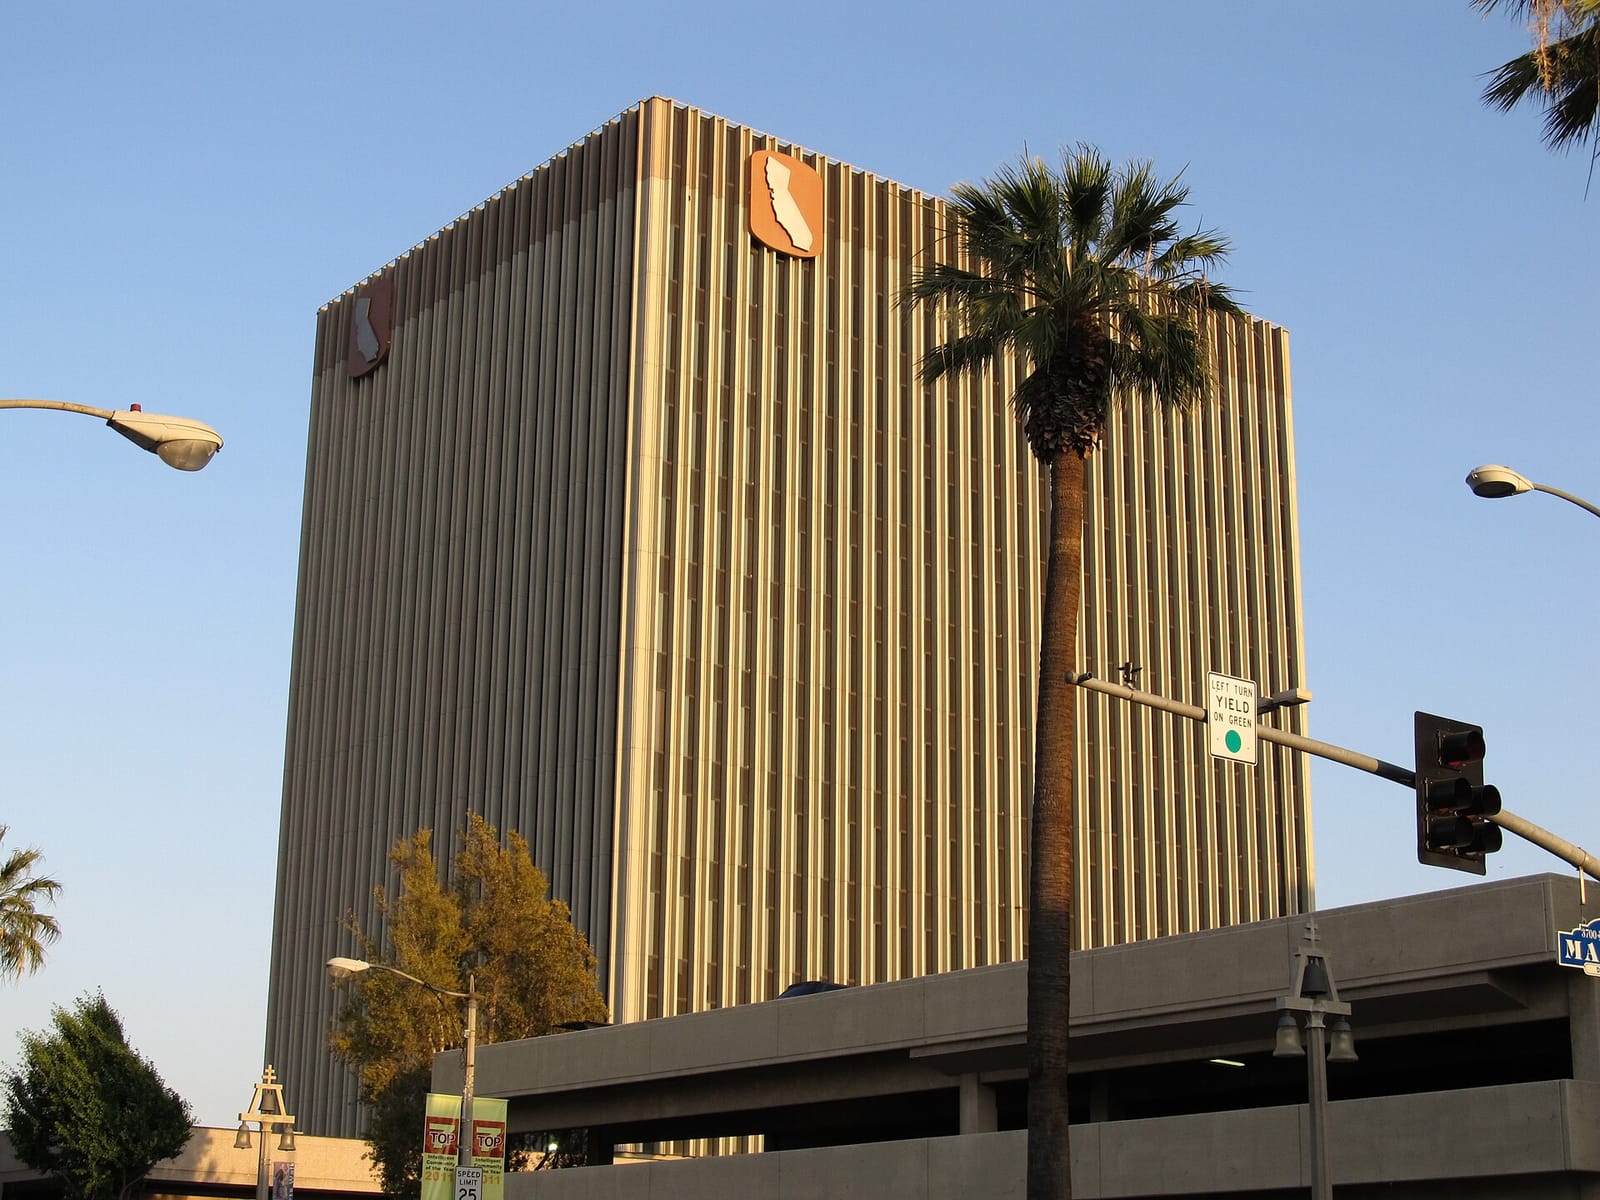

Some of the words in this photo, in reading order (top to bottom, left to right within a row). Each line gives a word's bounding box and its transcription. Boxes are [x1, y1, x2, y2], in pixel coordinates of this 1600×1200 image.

[1212, 680, 1229, 692] LEFT
[1235, 685, 1253, 697] TURN
[1216, 695, 1250, 713] YIELD
[1214, 711, 1223, 722] ON
[1229, 715, 1251, 728] GREEN
[431, 1132, 455, 1145] TOP
[478, 1136, 501, 1148] TOP
[425, 1171, 454, 1183] 2011
[482, 1175, 500, 1185] 011
[459, 1189, 477, 1200] 25
